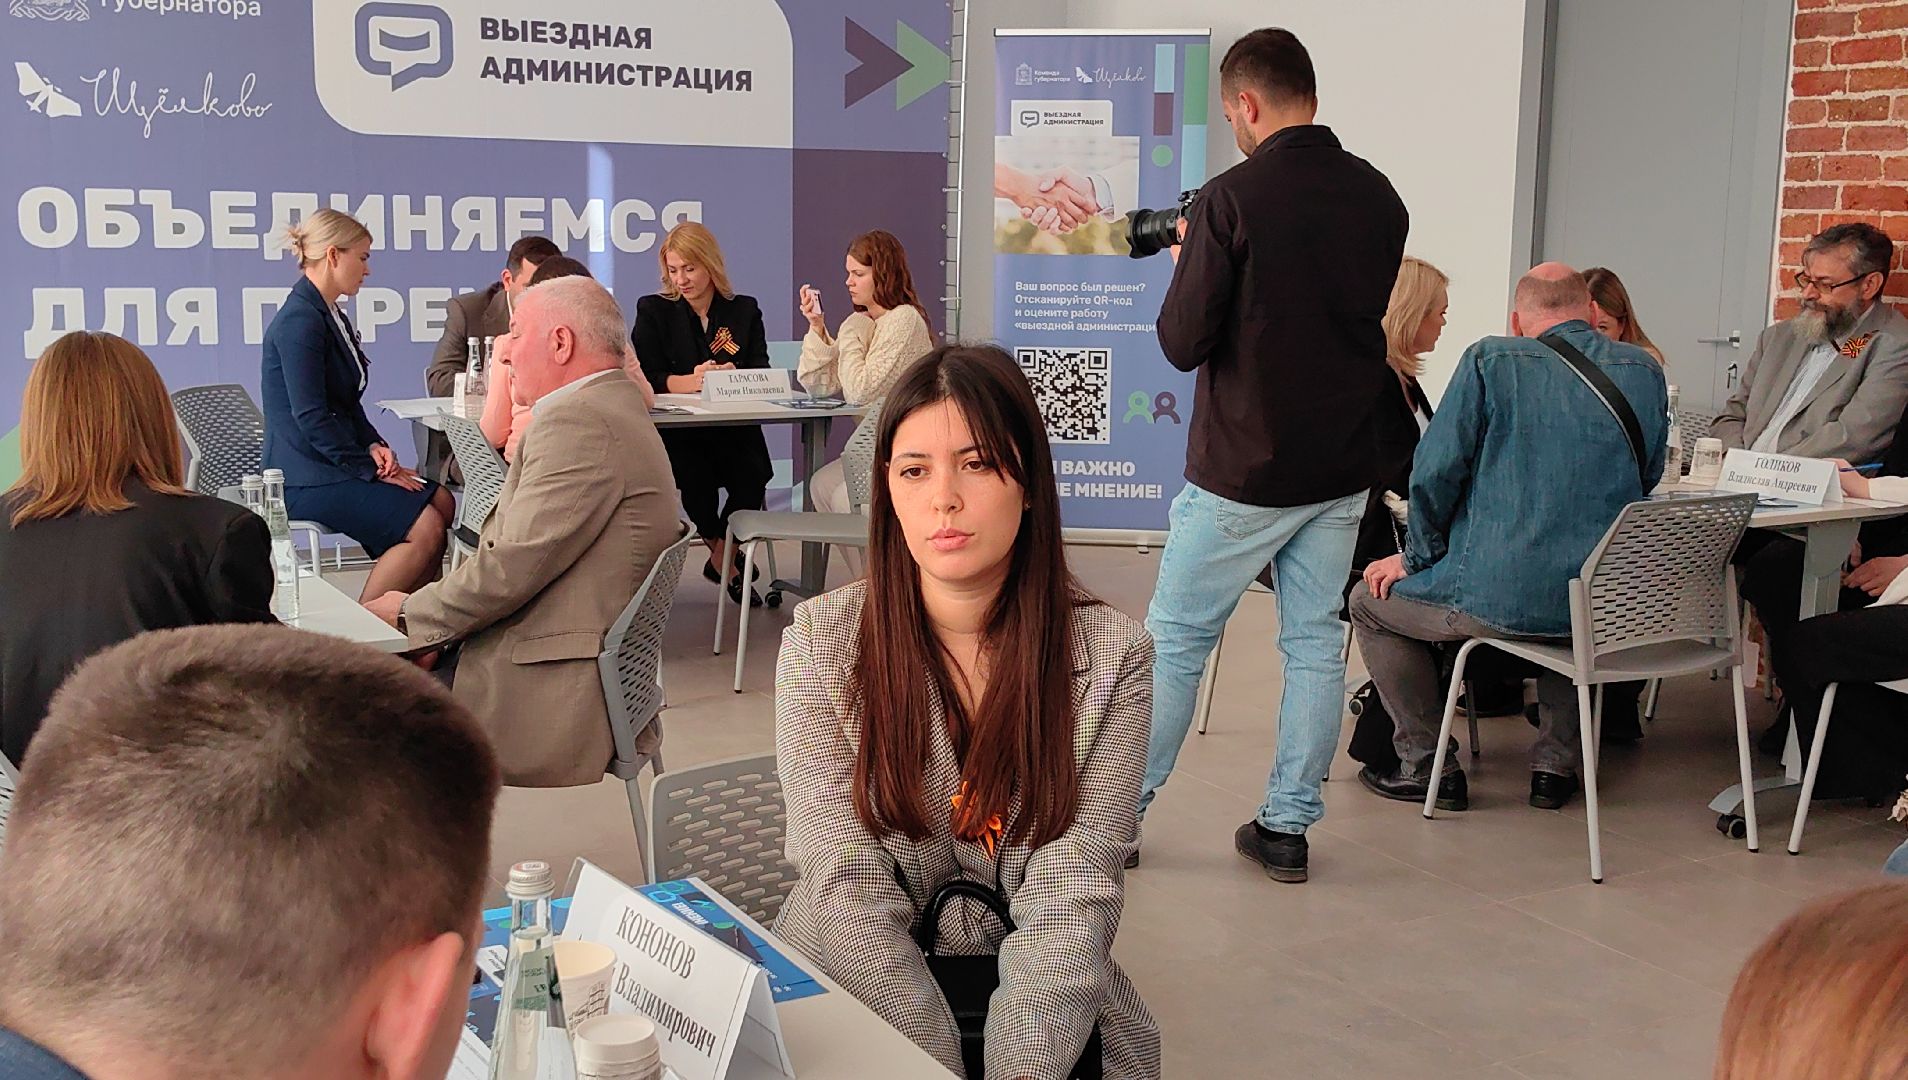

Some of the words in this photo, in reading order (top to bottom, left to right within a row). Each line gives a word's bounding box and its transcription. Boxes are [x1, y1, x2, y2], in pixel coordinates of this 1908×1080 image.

[480, 17, 653, 50] ВЫЕЗДНАЯ
[480, 56, 752, 94] АДМИНИСТРАЦИЯ
[1015, 282, 1038, 291] Ваш
[1040, 283, 1079, 293] вопрос
[1081, 282, 1102, 291] был
[1104, 283, 1146, 293] решен?
[1015, 294, 1092, 305] Отсканируйте
[1094, 296, 1133, 306] QR-код
[1024, 309, 1069, 318] оцените
[1070, 309, 1109, 319] работу
[24, 287, 219, 359] ДЛЯ
[1014, 321, 1074, 331] «выездной
[1076, 323, 1156, 333] администраци
[728, 373, 769, 384] ТАРАСОВА
[716, 387, 741, 397] Мария
[742, 386, 785, 395] Николаевна
[1061, 460, 1136, 477] ВАЖНО
[1754, 457, 1801, 473] ГОЛИКОВ
[1074, 482, 1162, 499] МНЕНИЕ!
[1728, 471, 1770, 487] Владислав
[1771, 478, 1818, 493] Андреевич
[616, 905, 696, 979] КОНОНОВ
[614, 962, 717, 1058] Владимирович
